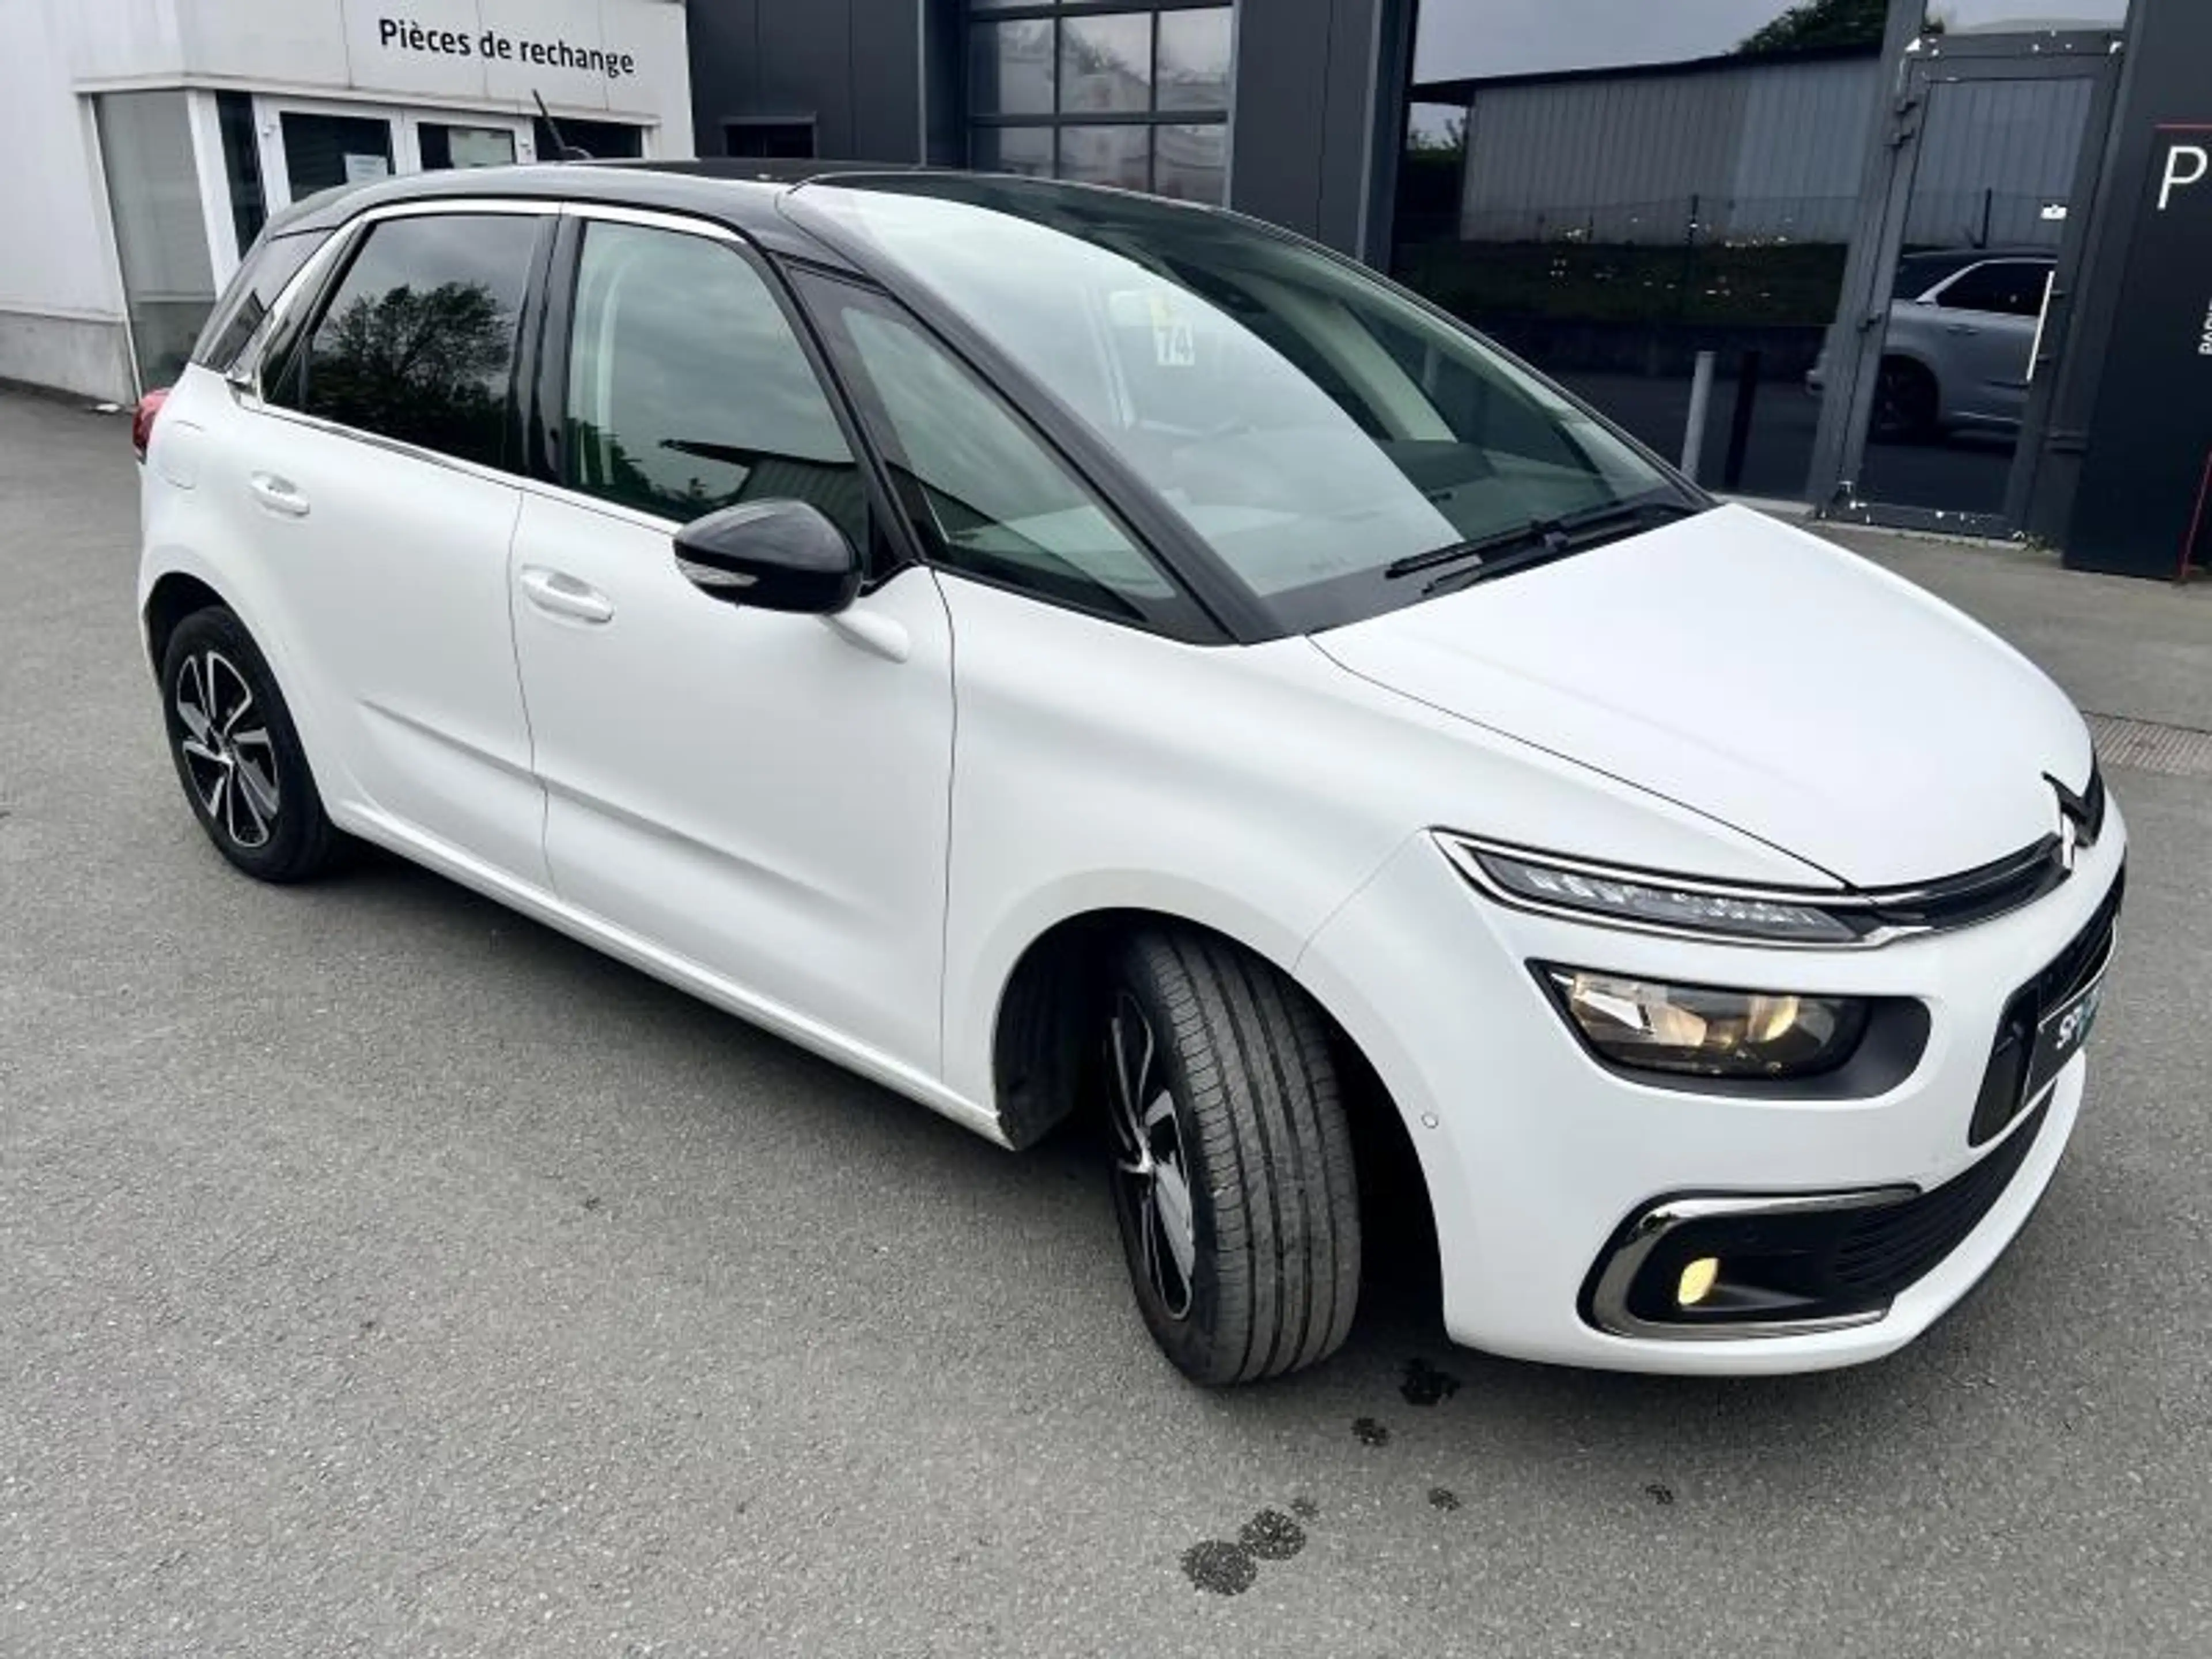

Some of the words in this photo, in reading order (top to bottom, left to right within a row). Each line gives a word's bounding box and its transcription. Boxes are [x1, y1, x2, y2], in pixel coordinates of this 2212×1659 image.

[378, 18, 471, 56] Pièces
[480, 31, 512, 59] de
[520, 40, 635, 78] rechange
